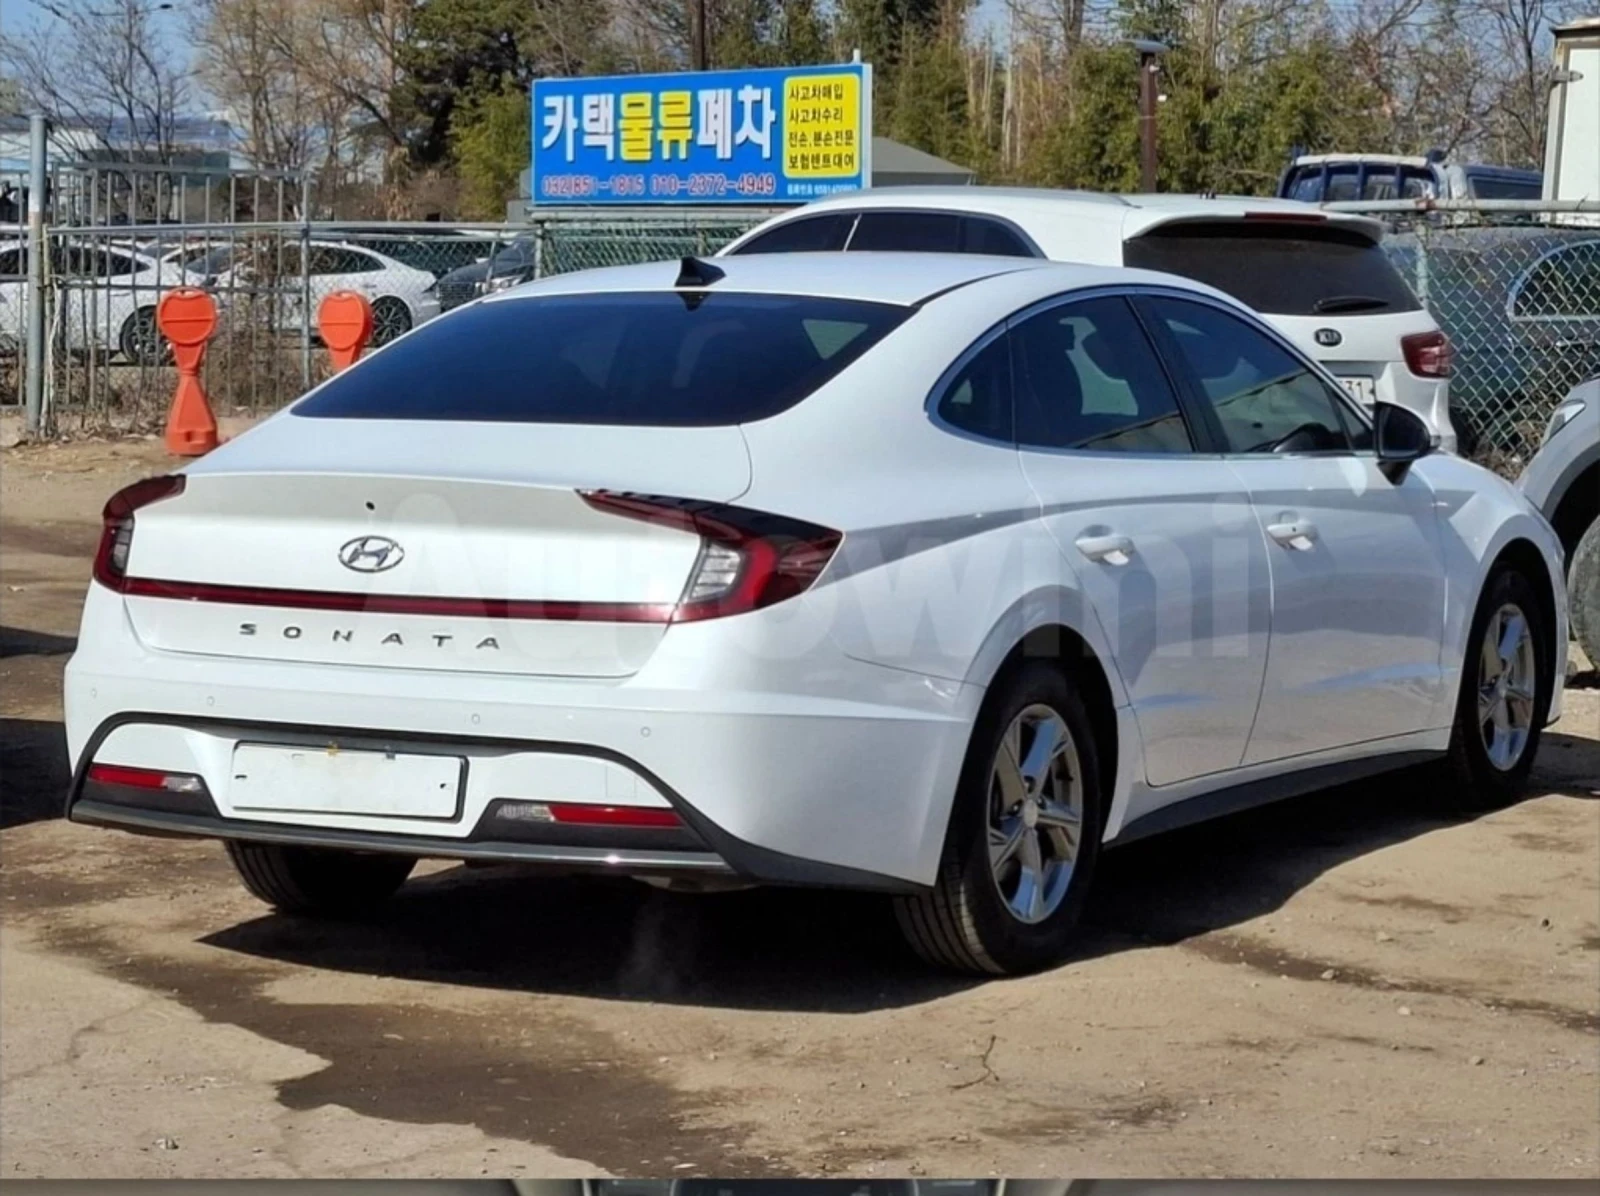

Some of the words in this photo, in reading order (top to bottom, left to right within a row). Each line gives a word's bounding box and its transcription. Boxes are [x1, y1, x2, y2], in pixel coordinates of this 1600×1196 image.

[542, 84, 776, 162] 카택물류폐차
[789, 106, 843, 124] 사고차수리
[650, 172, 776, 196] 010-2372-4949
[1316, 328, 1341, 345] KIA
[239, 622, 500, 650] SONATA
